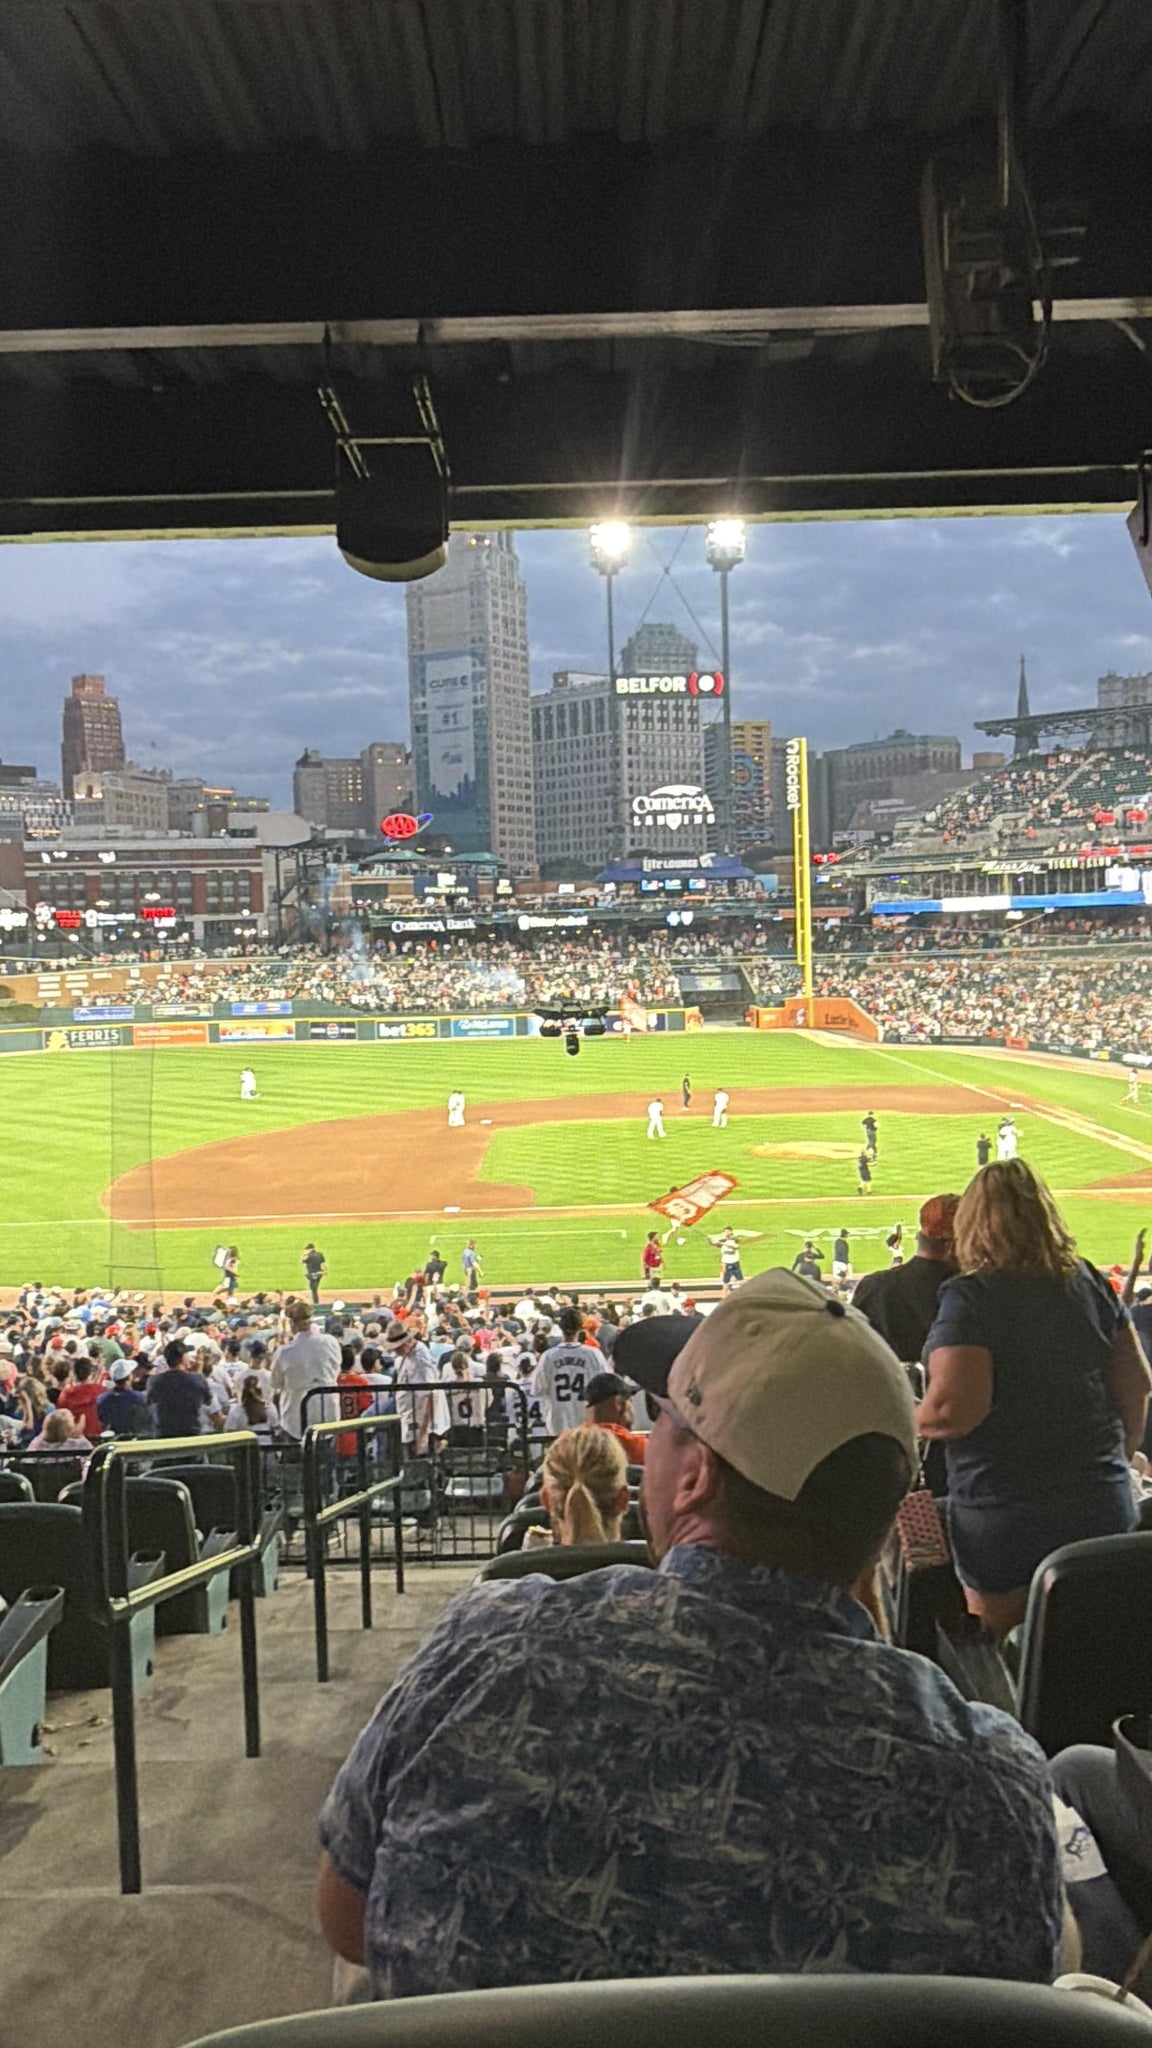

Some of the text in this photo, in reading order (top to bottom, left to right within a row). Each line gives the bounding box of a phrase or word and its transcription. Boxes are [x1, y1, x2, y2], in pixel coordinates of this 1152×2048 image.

[616, 676, 686, 694] BELFOR
[786, 755, 800, 811] Rocket
[384, 815, 416, 834] AAA
[633, 814, 716, 827] LANING
[664, 858, 699, 869] LOUNGE
[446, 918, 476, 930] Bank
[70, 1029, 119, 1042] FERRIS
[379, 1022, 436, 1037] bet365
[554, 1373, 586, 1402] 24
